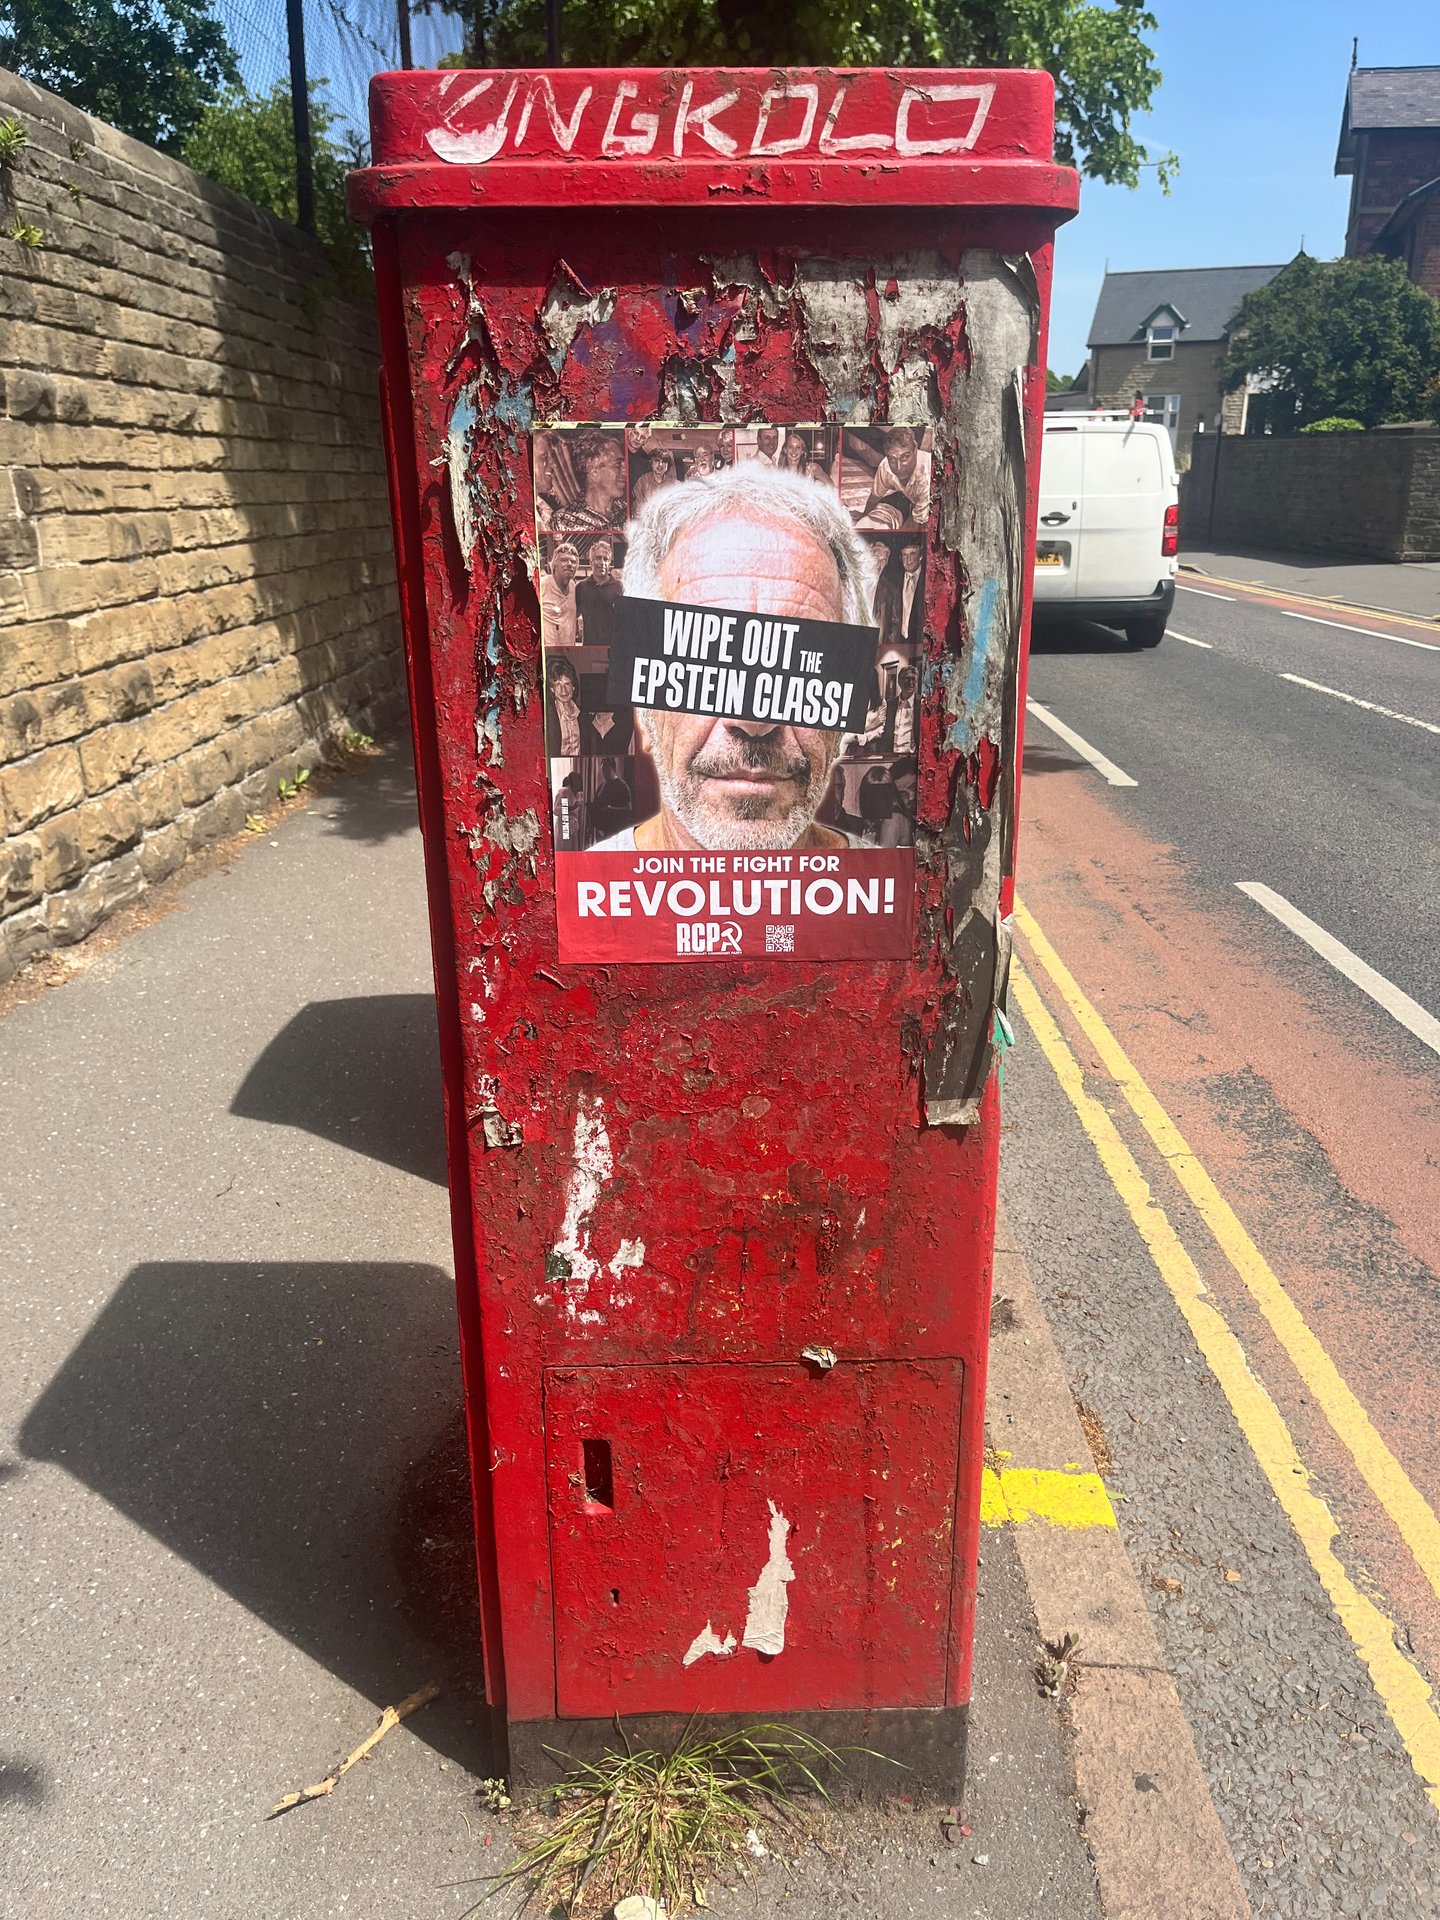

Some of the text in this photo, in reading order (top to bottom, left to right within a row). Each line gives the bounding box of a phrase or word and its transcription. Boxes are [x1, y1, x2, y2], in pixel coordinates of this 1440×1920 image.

[663, 608, 824, 674] WIPE OUT THE
[630, 657, 854, 728] EPSTEIN CLASS!
[632, 855, 840, 874] JOIN THE FIGHT FOR
[577, 877, 895, 917] REVOLUTION!
[676, 922, 720, 952] RCP
